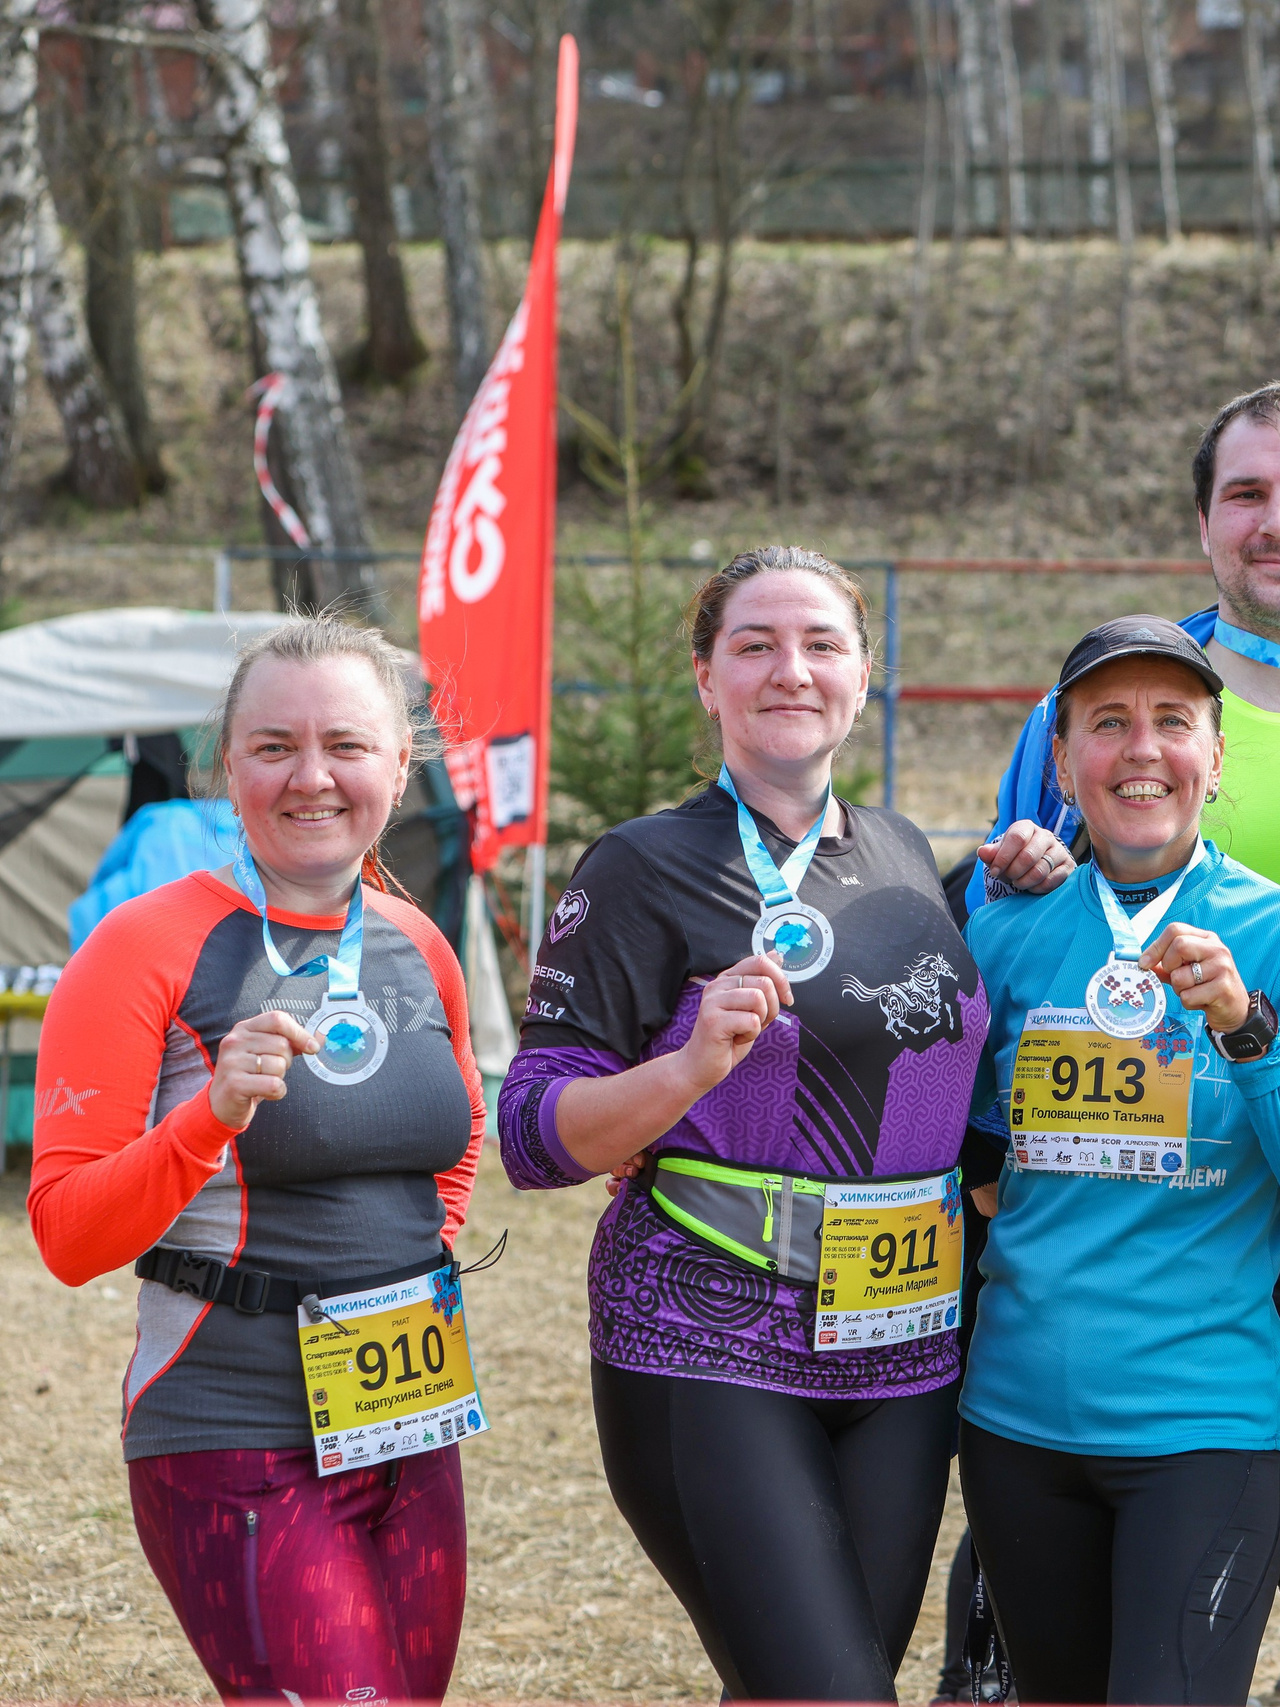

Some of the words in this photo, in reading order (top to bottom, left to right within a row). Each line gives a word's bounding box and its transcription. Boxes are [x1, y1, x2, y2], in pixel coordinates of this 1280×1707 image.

[1088, 1041, 1112, 1049] УФКиС
[1051, 1055, 1146, 1104] 913
[1031, 1107, 1109, 1122] Головащенко
[1113, 1110, 1164, 1124] Татьяна
[840, 1188, 916, 1203] ХИМКИНСКИЙ
[916, 1186, 933, 1198] ЛЕС
[903, 1214, 922, 1223] УФКиС
[869, 1224, 939, 1279] 911
[400, 1286, 420, 1300] ЛЕС
[864, 1285, 903, 1299] Лучина
[906, 1276, 938, 1291] Марина
[909, 1305, 922, 1314] SCOR
[392, 1317, 410, 1328] РМАТ
[306, 1346, 353, 1361] Спартакиада
[356, 1325, 445, 1391] 910
[355, 1387, 422, 1413] Карпухина
[425, 1378, 454, 1396] Елена
[421, 1413, 439, 1423] SCOR
[321, 1435, 338, 1444] EASY
